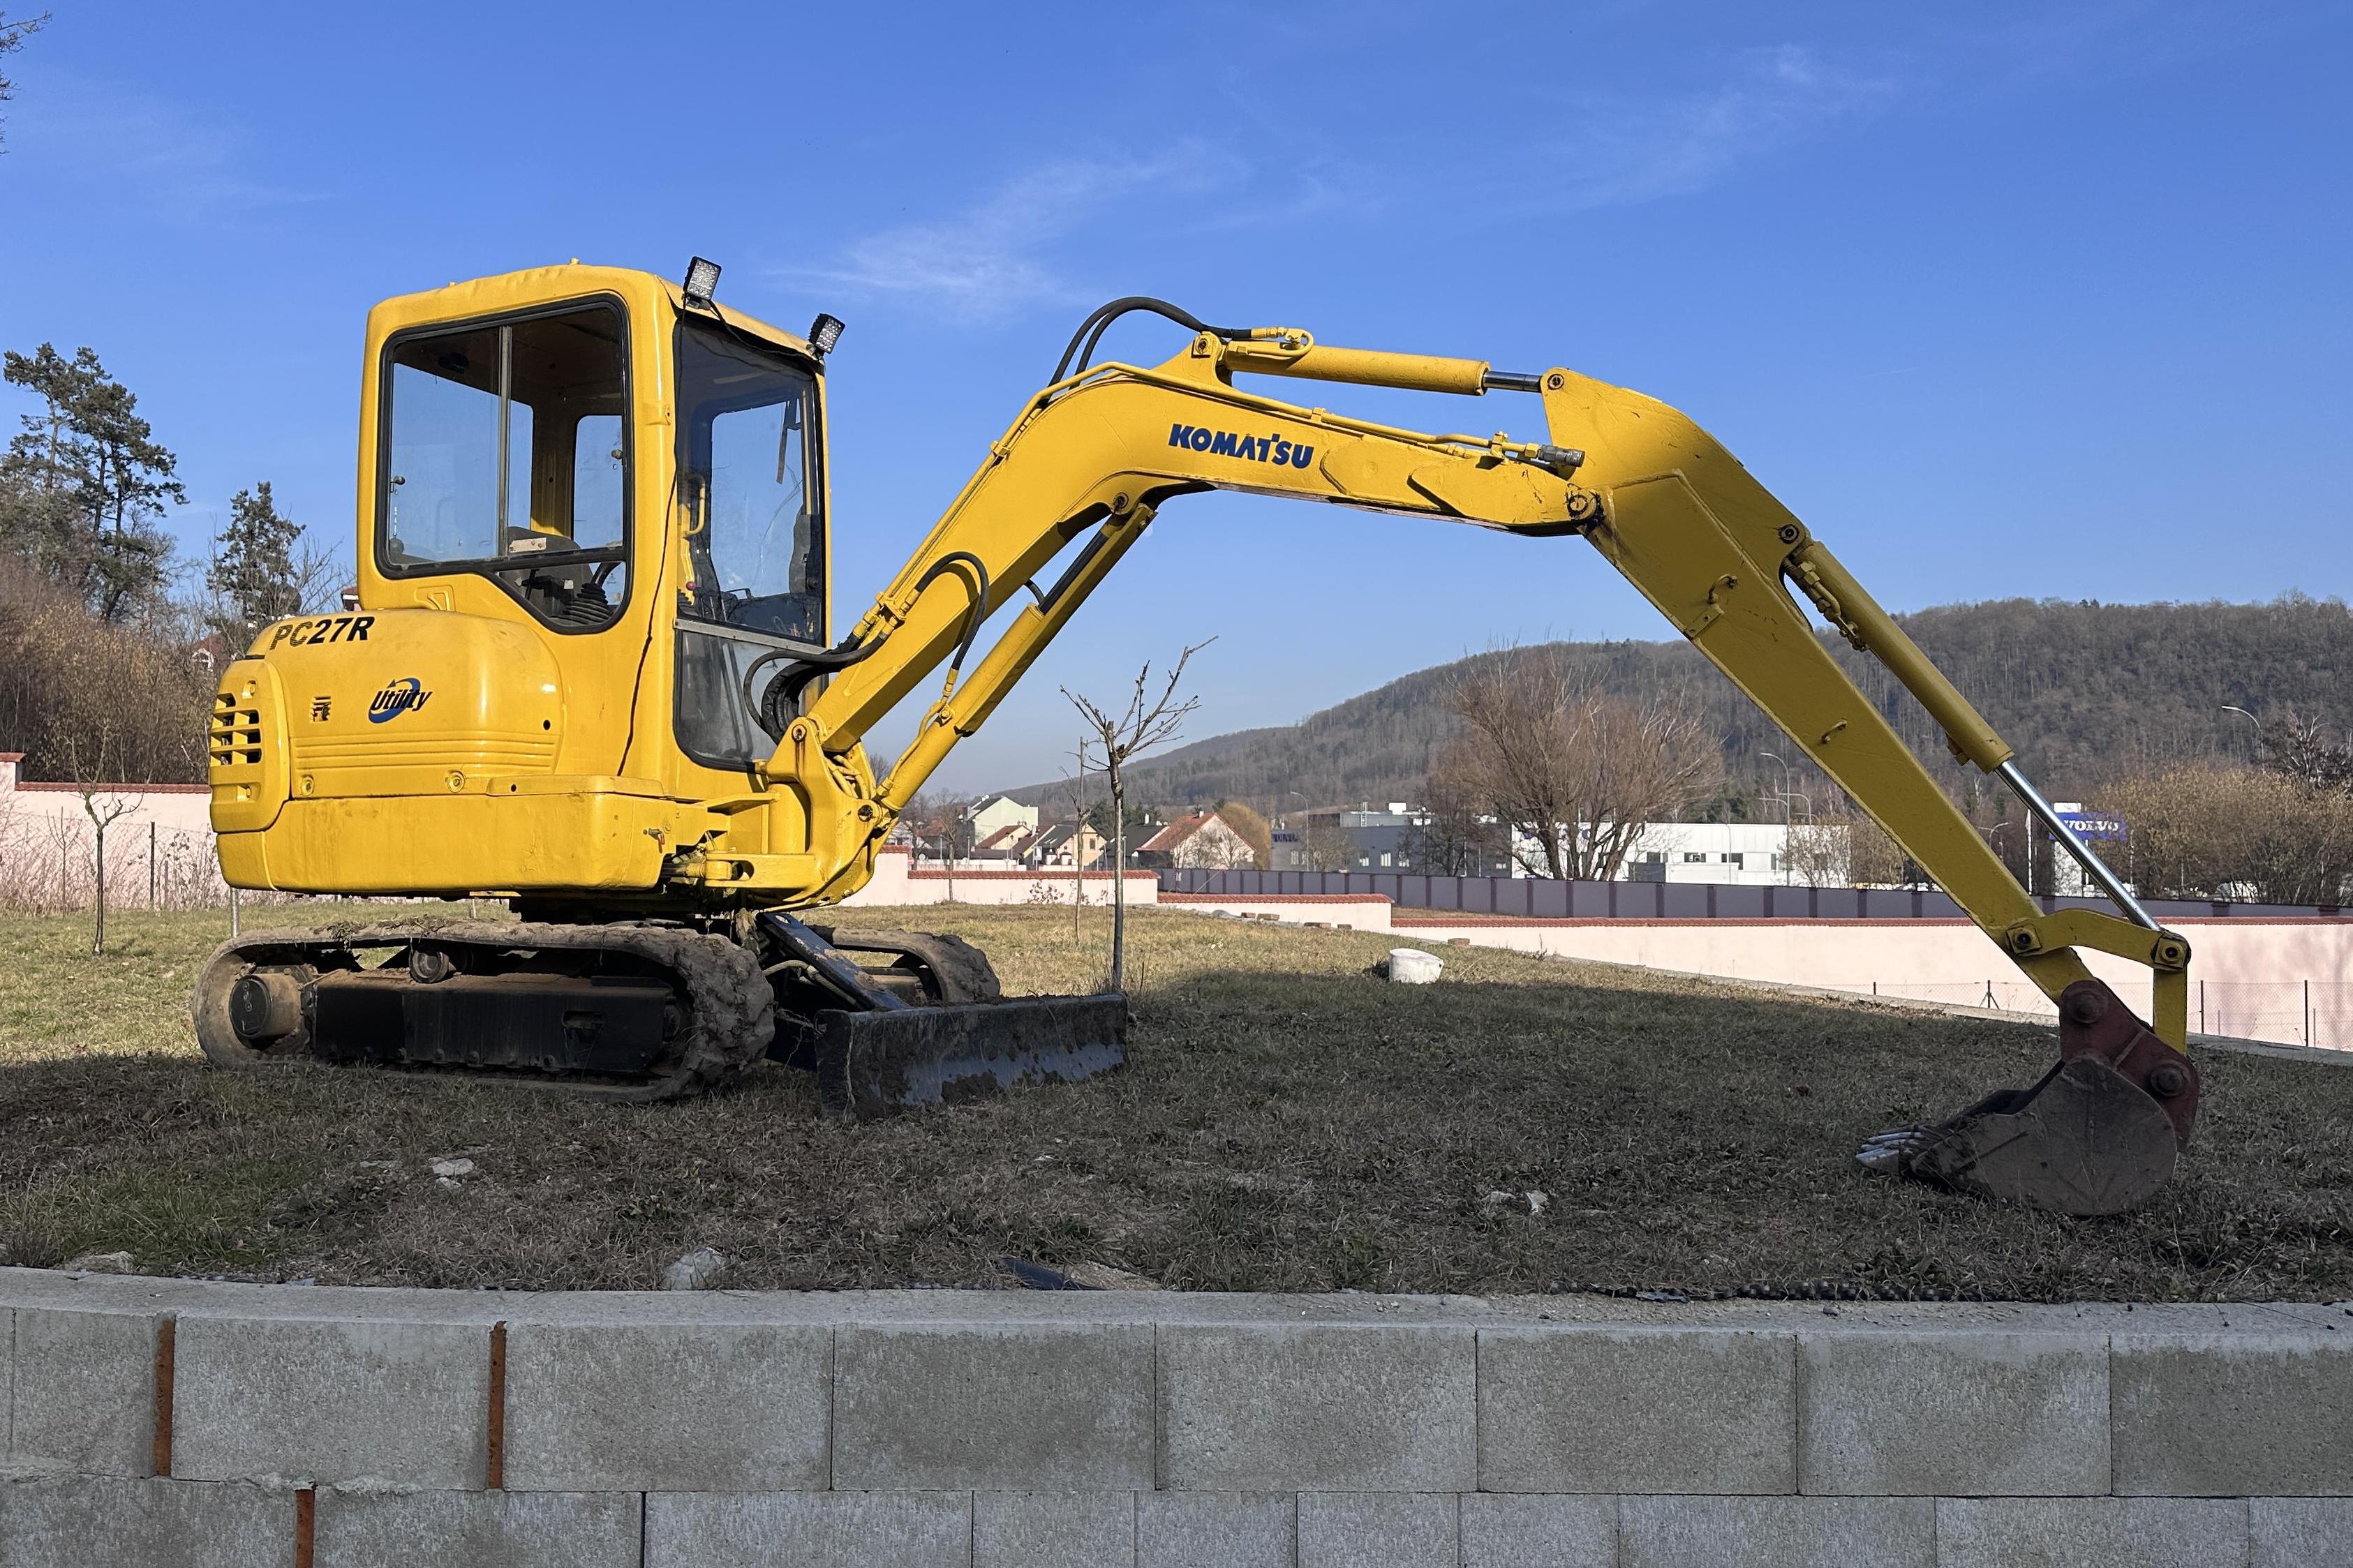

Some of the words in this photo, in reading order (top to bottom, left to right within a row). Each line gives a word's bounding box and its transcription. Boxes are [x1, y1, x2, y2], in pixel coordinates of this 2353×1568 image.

[1168, 424, 1314, 469] KOMATSU
[269, 616, 375, 650] PC27R
[370, 689, 433, 712] Utility
